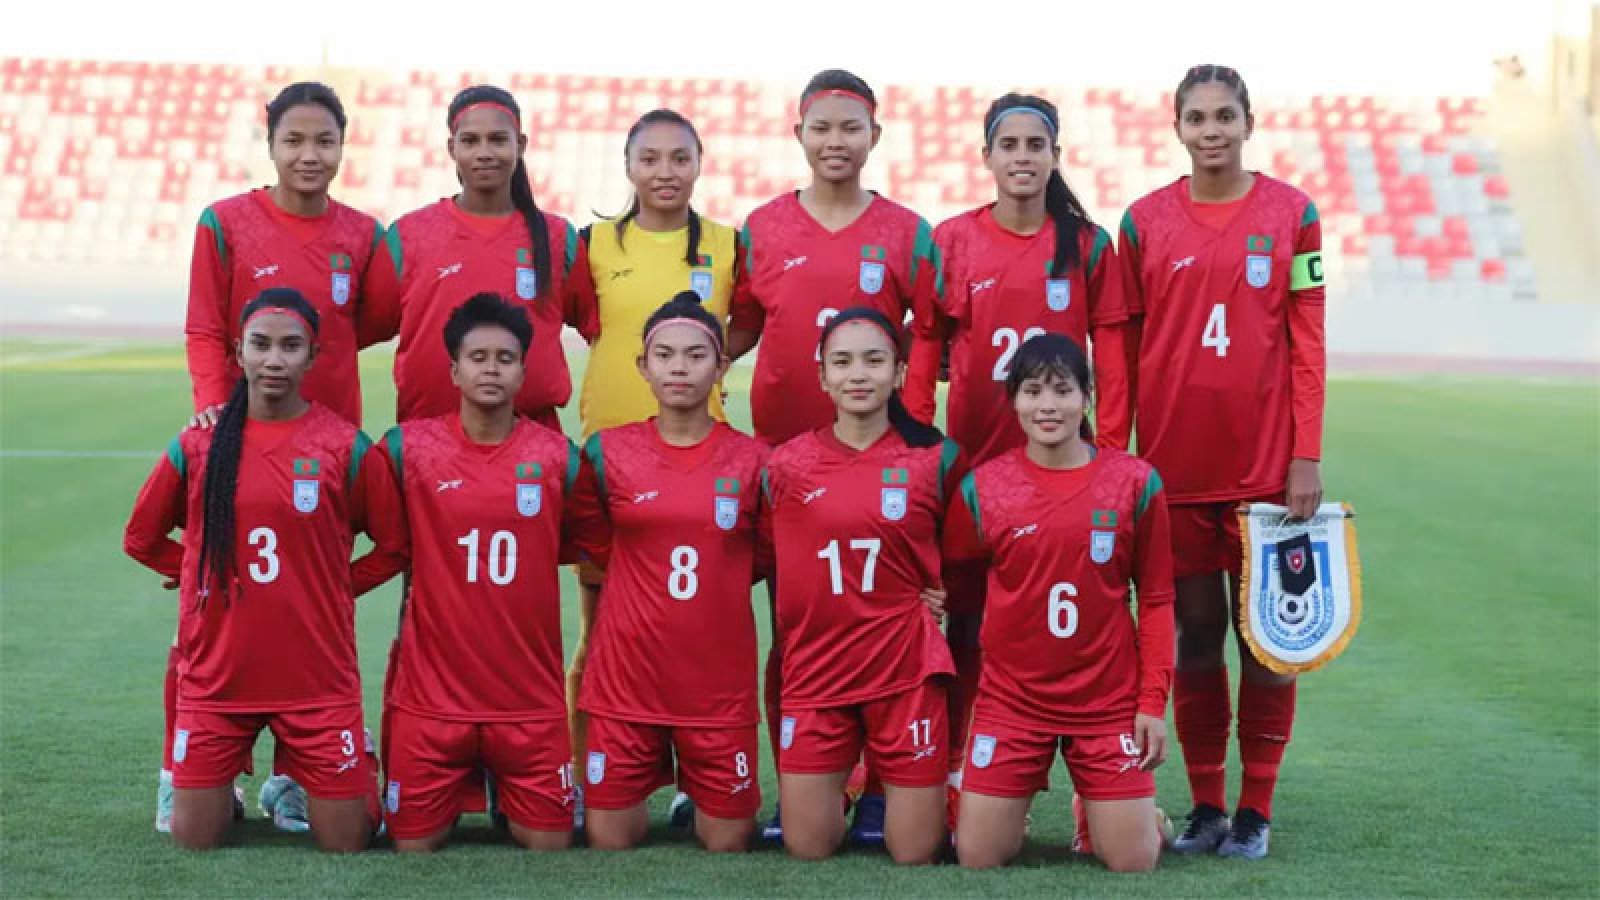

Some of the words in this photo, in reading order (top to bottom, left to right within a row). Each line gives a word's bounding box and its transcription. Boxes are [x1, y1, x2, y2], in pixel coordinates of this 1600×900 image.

[1308, 255, 1323, 282] C
[992, 327, 1047, 381] 2
[1202, 303, 1231, 357] 4
[248, 527, 279, 583] 3
[457, 528, 517, 585] 10
[668, 545, 699, 601] 8
[817, 537, 881, 595] 17
[1047, 581, 1079, 639] 6
[340, 729, 356, 757] 3
[907, 719, 931, 747] 17
[1120, 732, 1141, 756] 6
[734, 751, 749, 778] 8
